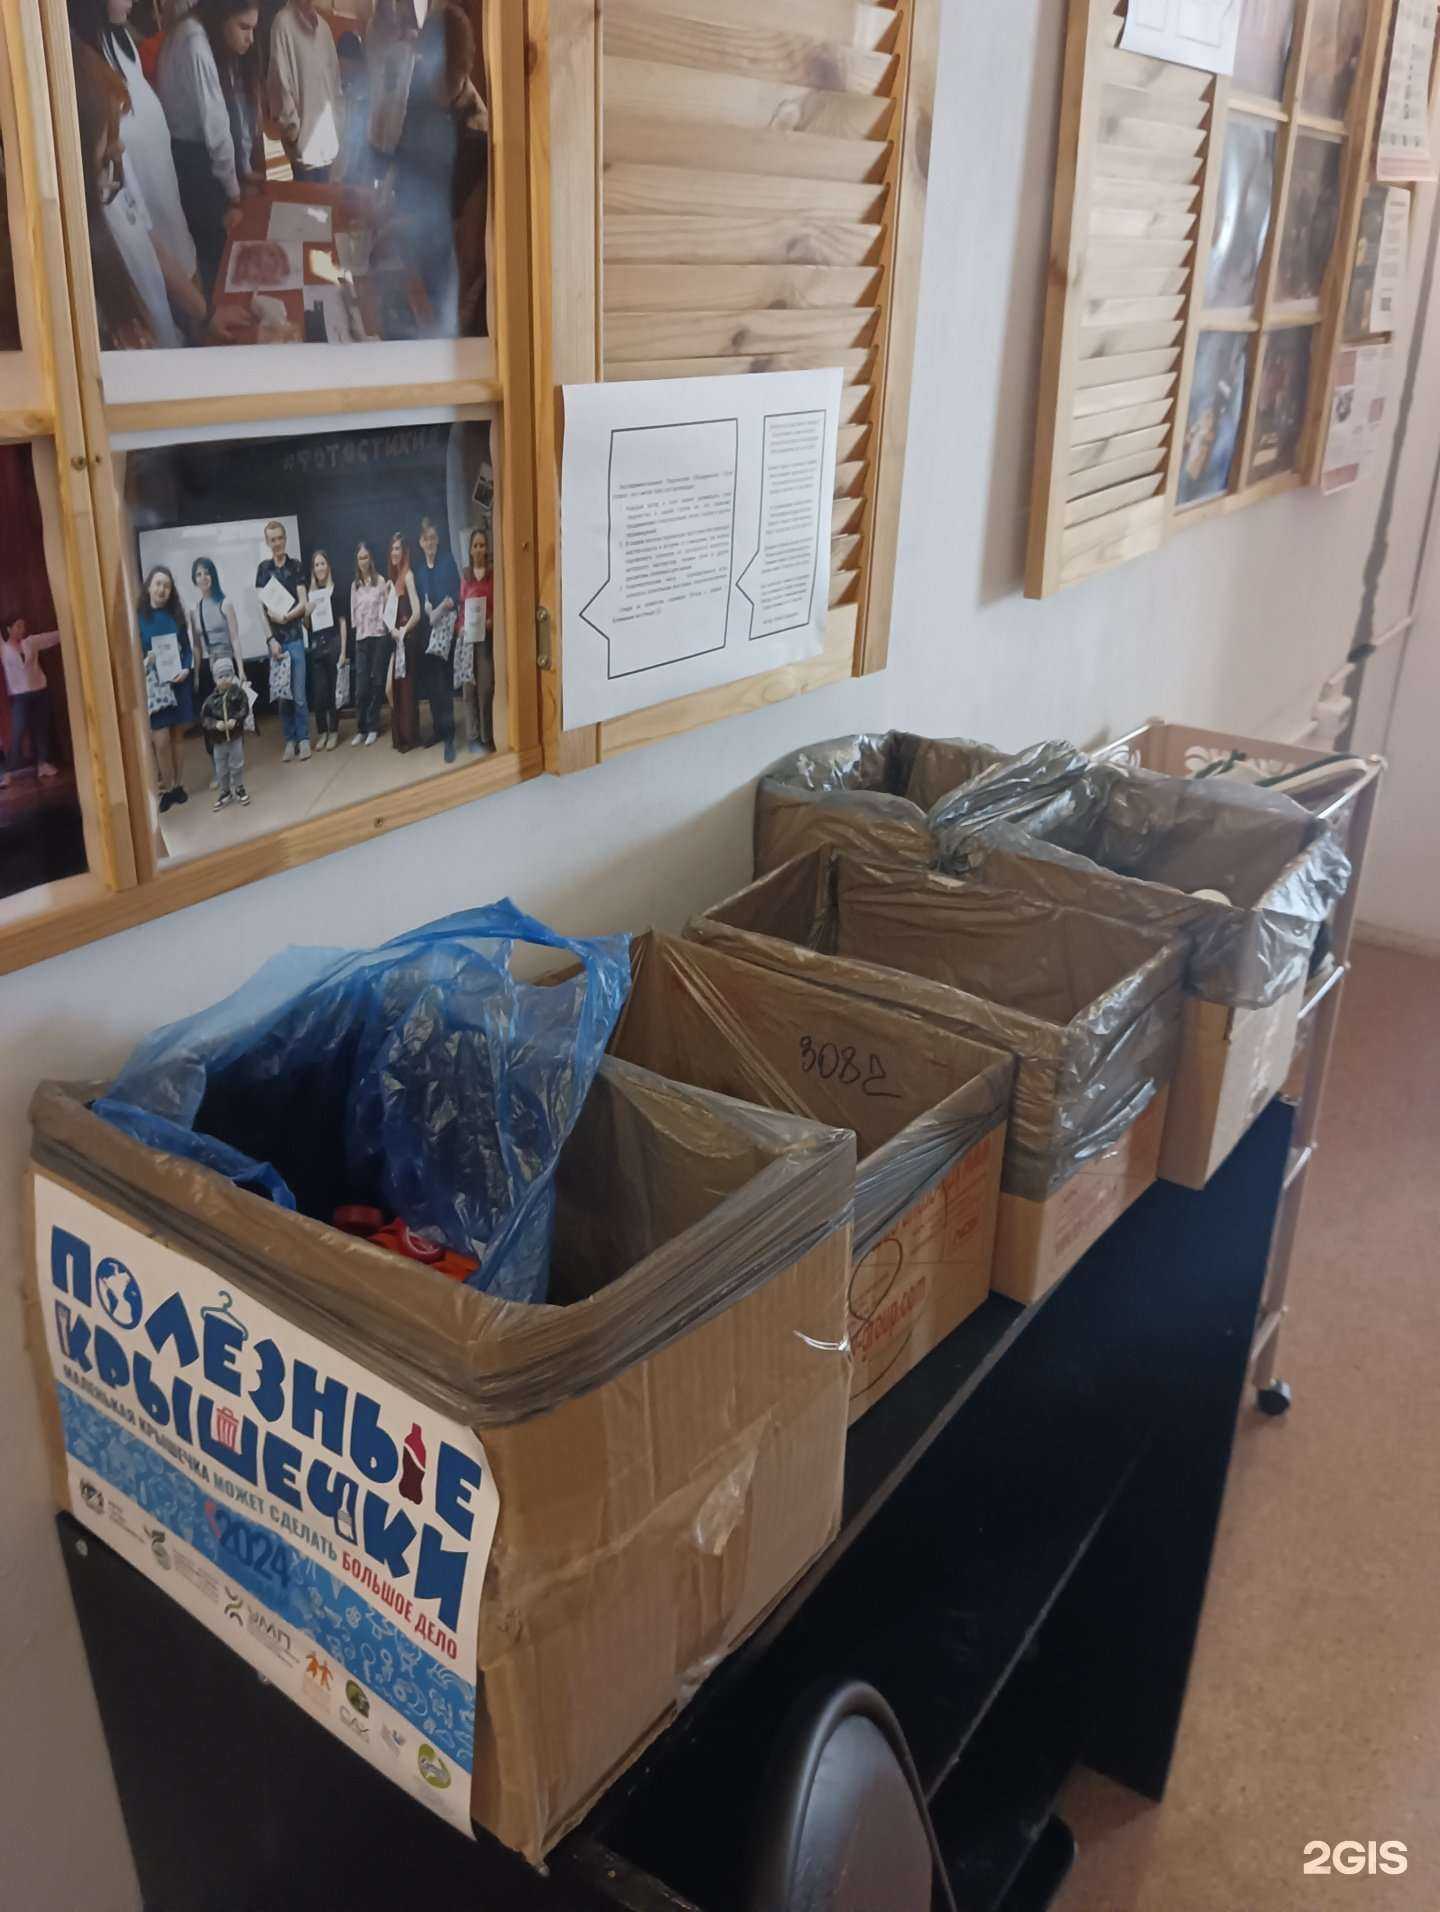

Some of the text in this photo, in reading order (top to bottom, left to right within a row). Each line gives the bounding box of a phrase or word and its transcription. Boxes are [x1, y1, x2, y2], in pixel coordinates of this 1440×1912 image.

[51, 1225, 482, 1541] ПОЛЕЗНЫЕ
[55, 1300, 469, 1634] КРЫШЕЧКИ
[213, 1473, 265, 1515] МОЖЕТ
[271, 1504, 338, 1561] СДЕЛАТЬ
[342, 1550, 413, 1623] БОЛЬШОЕ
[414, 1613, 458, 1660] ДЕЛО
[215, 1508, 290, 1588] 2024
